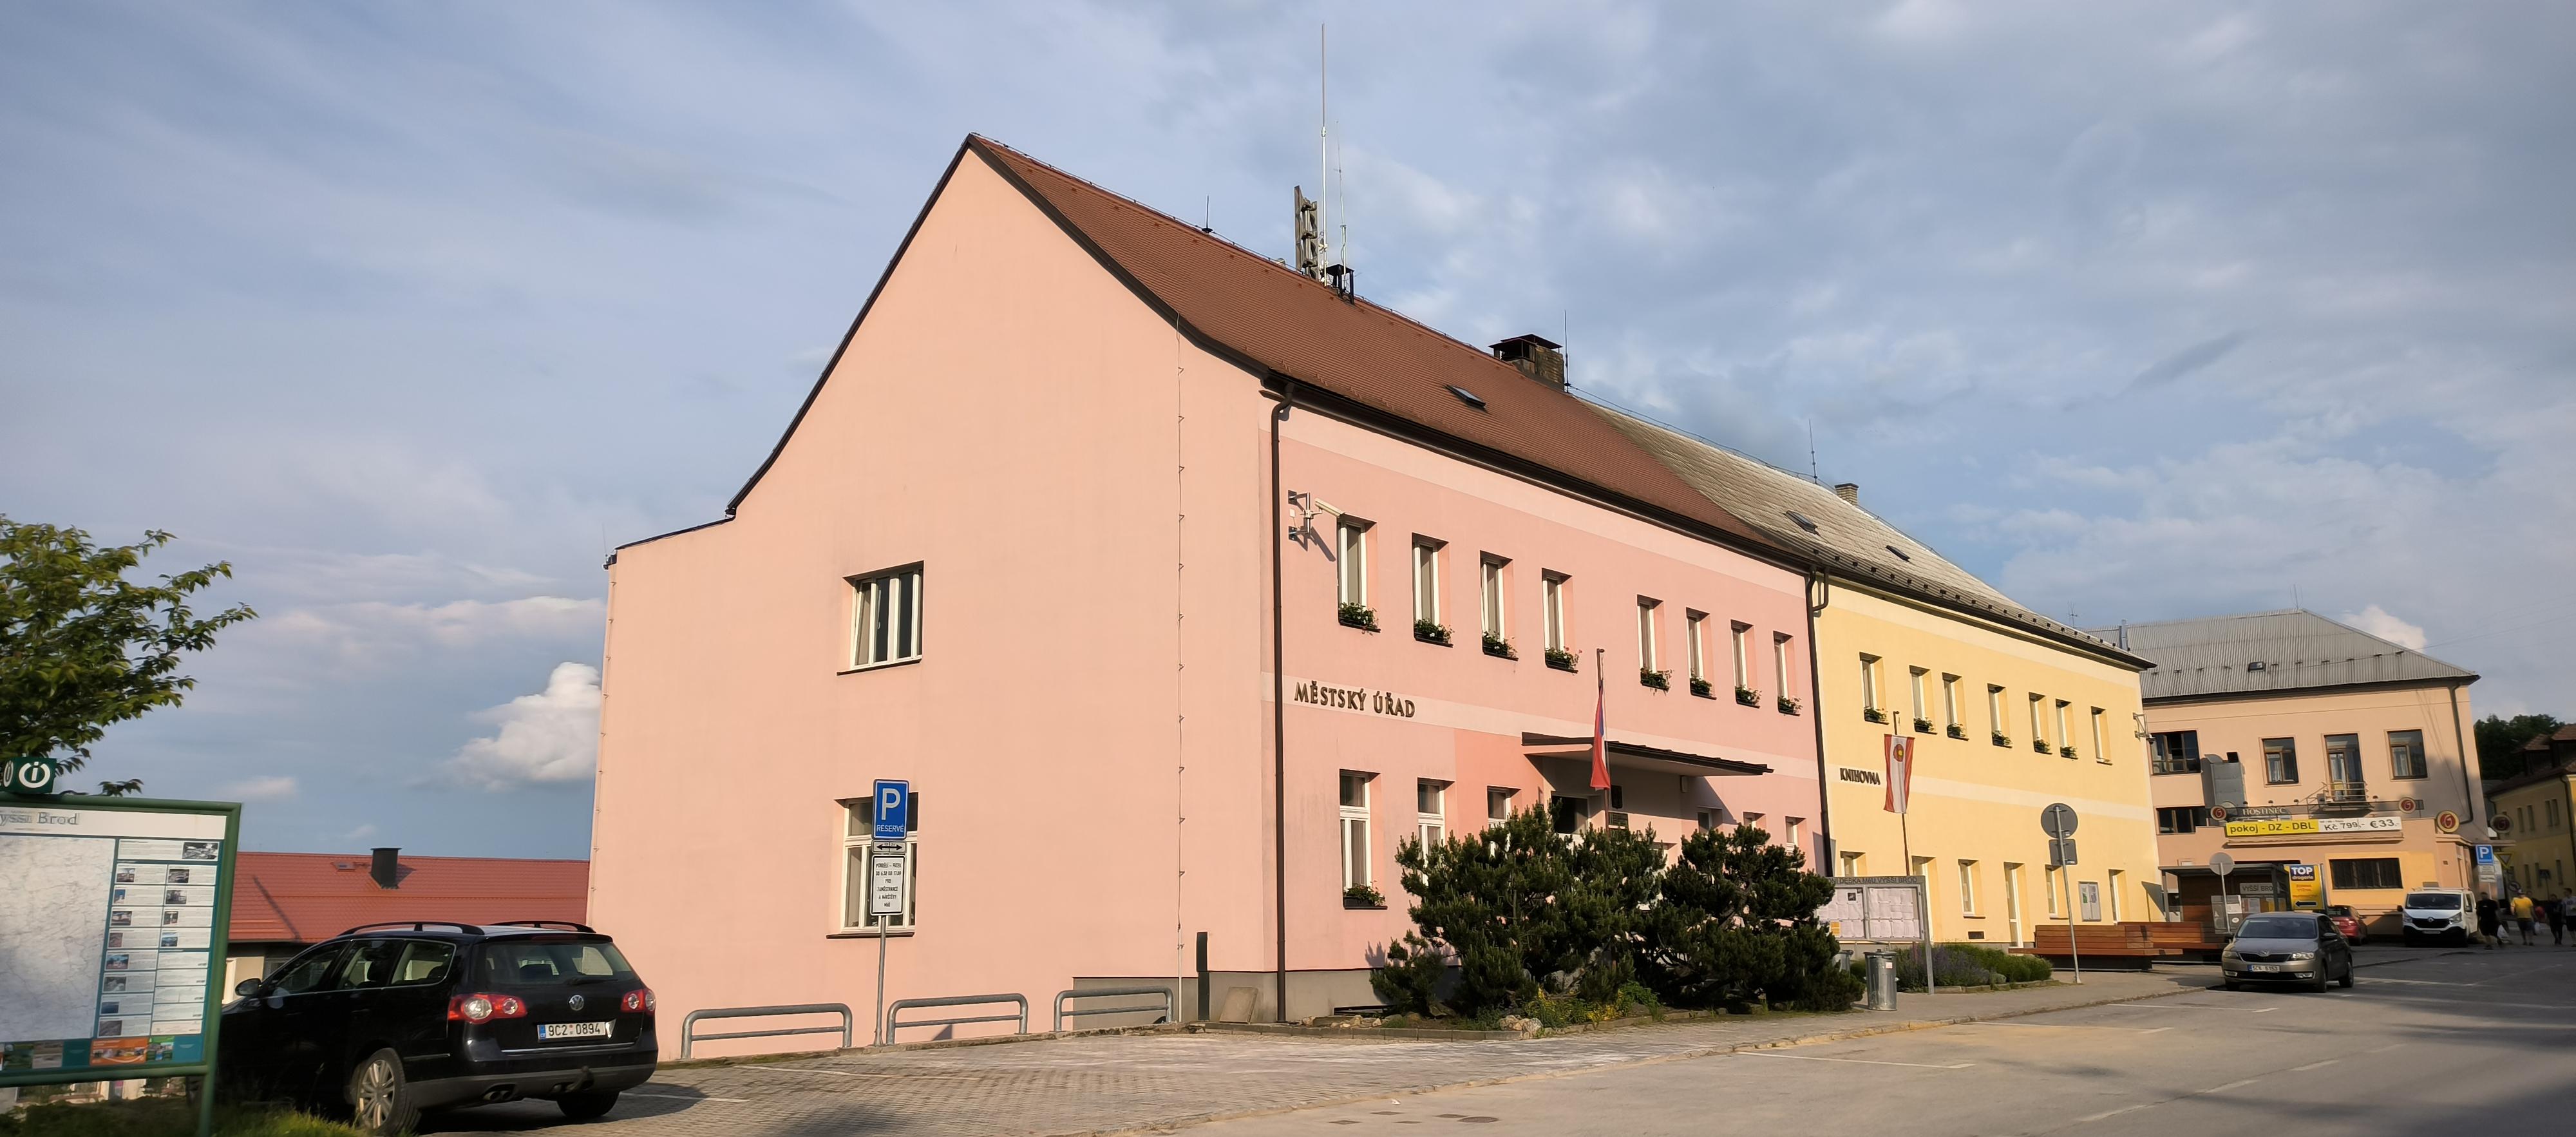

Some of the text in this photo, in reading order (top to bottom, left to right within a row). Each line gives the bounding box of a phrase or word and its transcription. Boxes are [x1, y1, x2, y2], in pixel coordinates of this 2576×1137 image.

[1294, 680, 1416, 718] MĚSTSKÝ ÚŘAD
[1839, 767, 1881, 785] KNIHOVNA
[881, 787, 901, 821] P
[2242, 807, 2286, 816] HOSTINEC
[37, 812, 79, 825] Brod
[2230, 824, 2259, 834] pokoj
[2479, 846, 2490, 859] P
[2291, 866, 2313, 875] TOP
[548, 1023, 600, 1037] 9C2 0894
